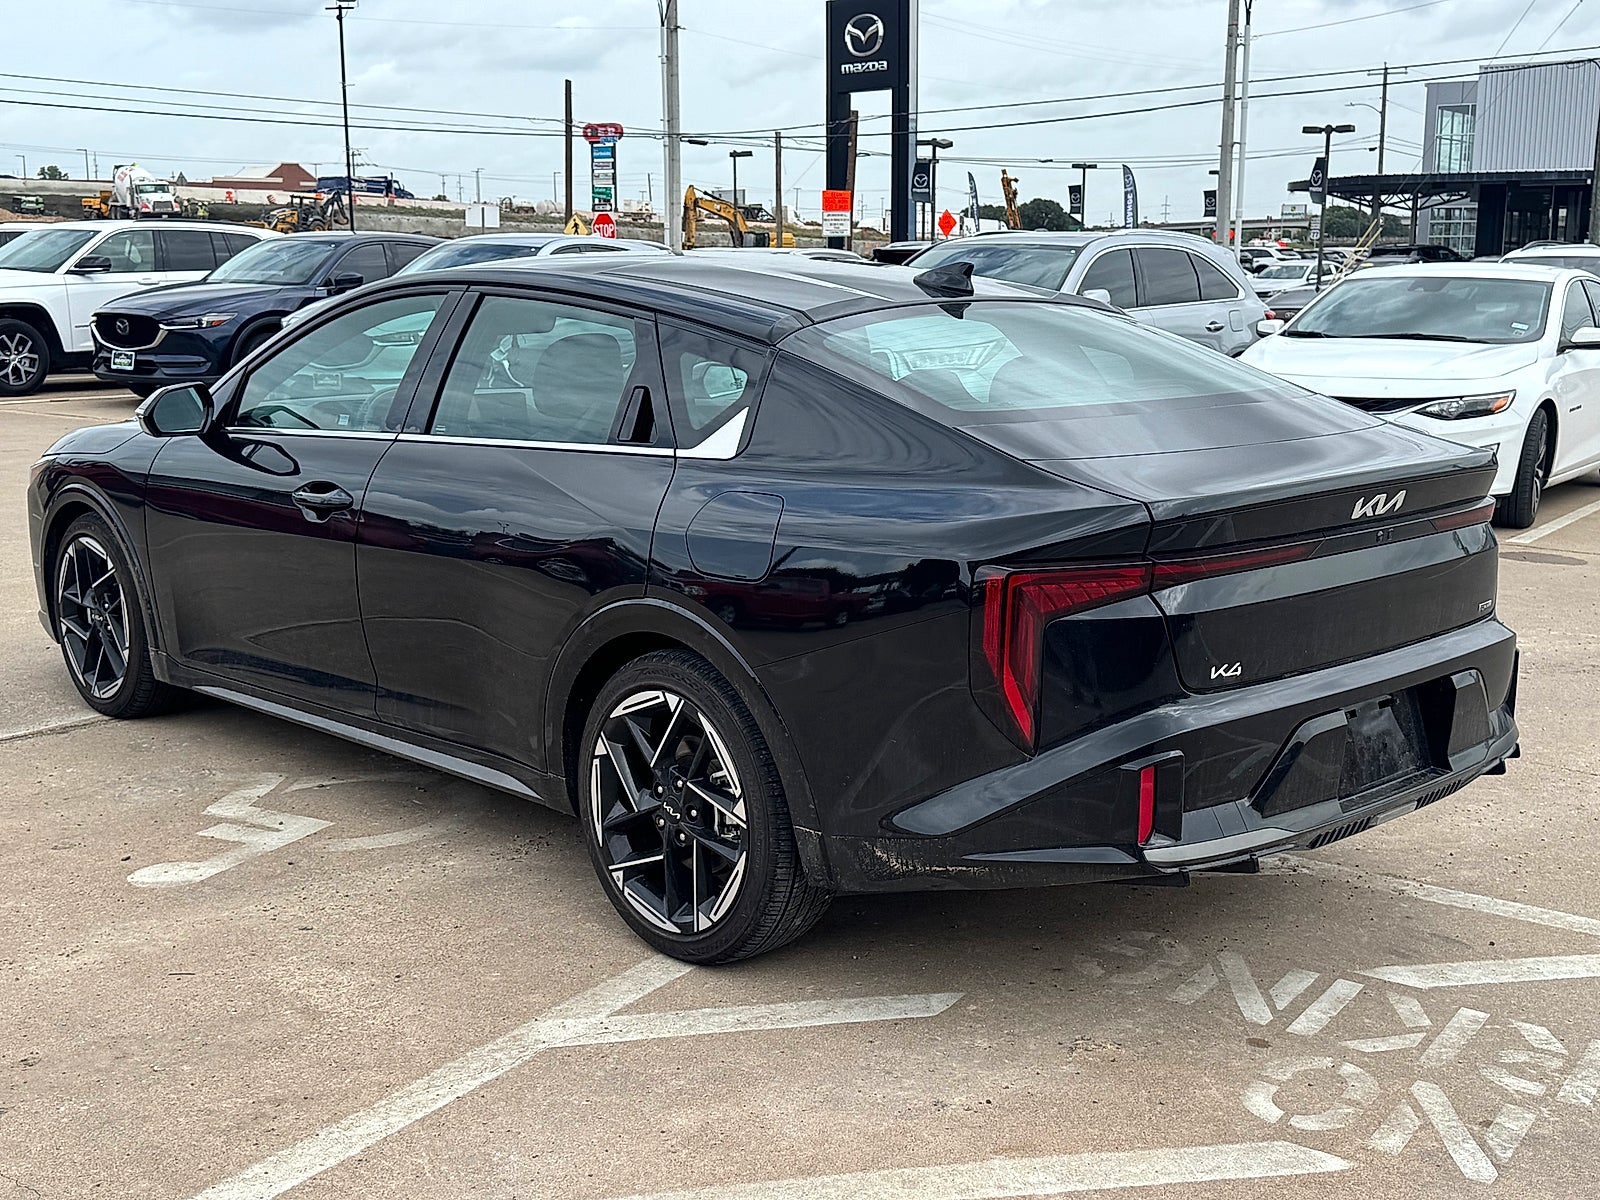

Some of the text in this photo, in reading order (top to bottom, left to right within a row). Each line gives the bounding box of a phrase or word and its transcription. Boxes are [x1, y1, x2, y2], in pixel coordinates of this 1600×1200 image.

[841, 60, 888, 75] mazda
[594, 223, 614, 237] STOP
[1351, 490, 1407, 519] KIA
[1211, 662, 1242, 680] K4
[1241, 1056, 1541, 1185] NO
